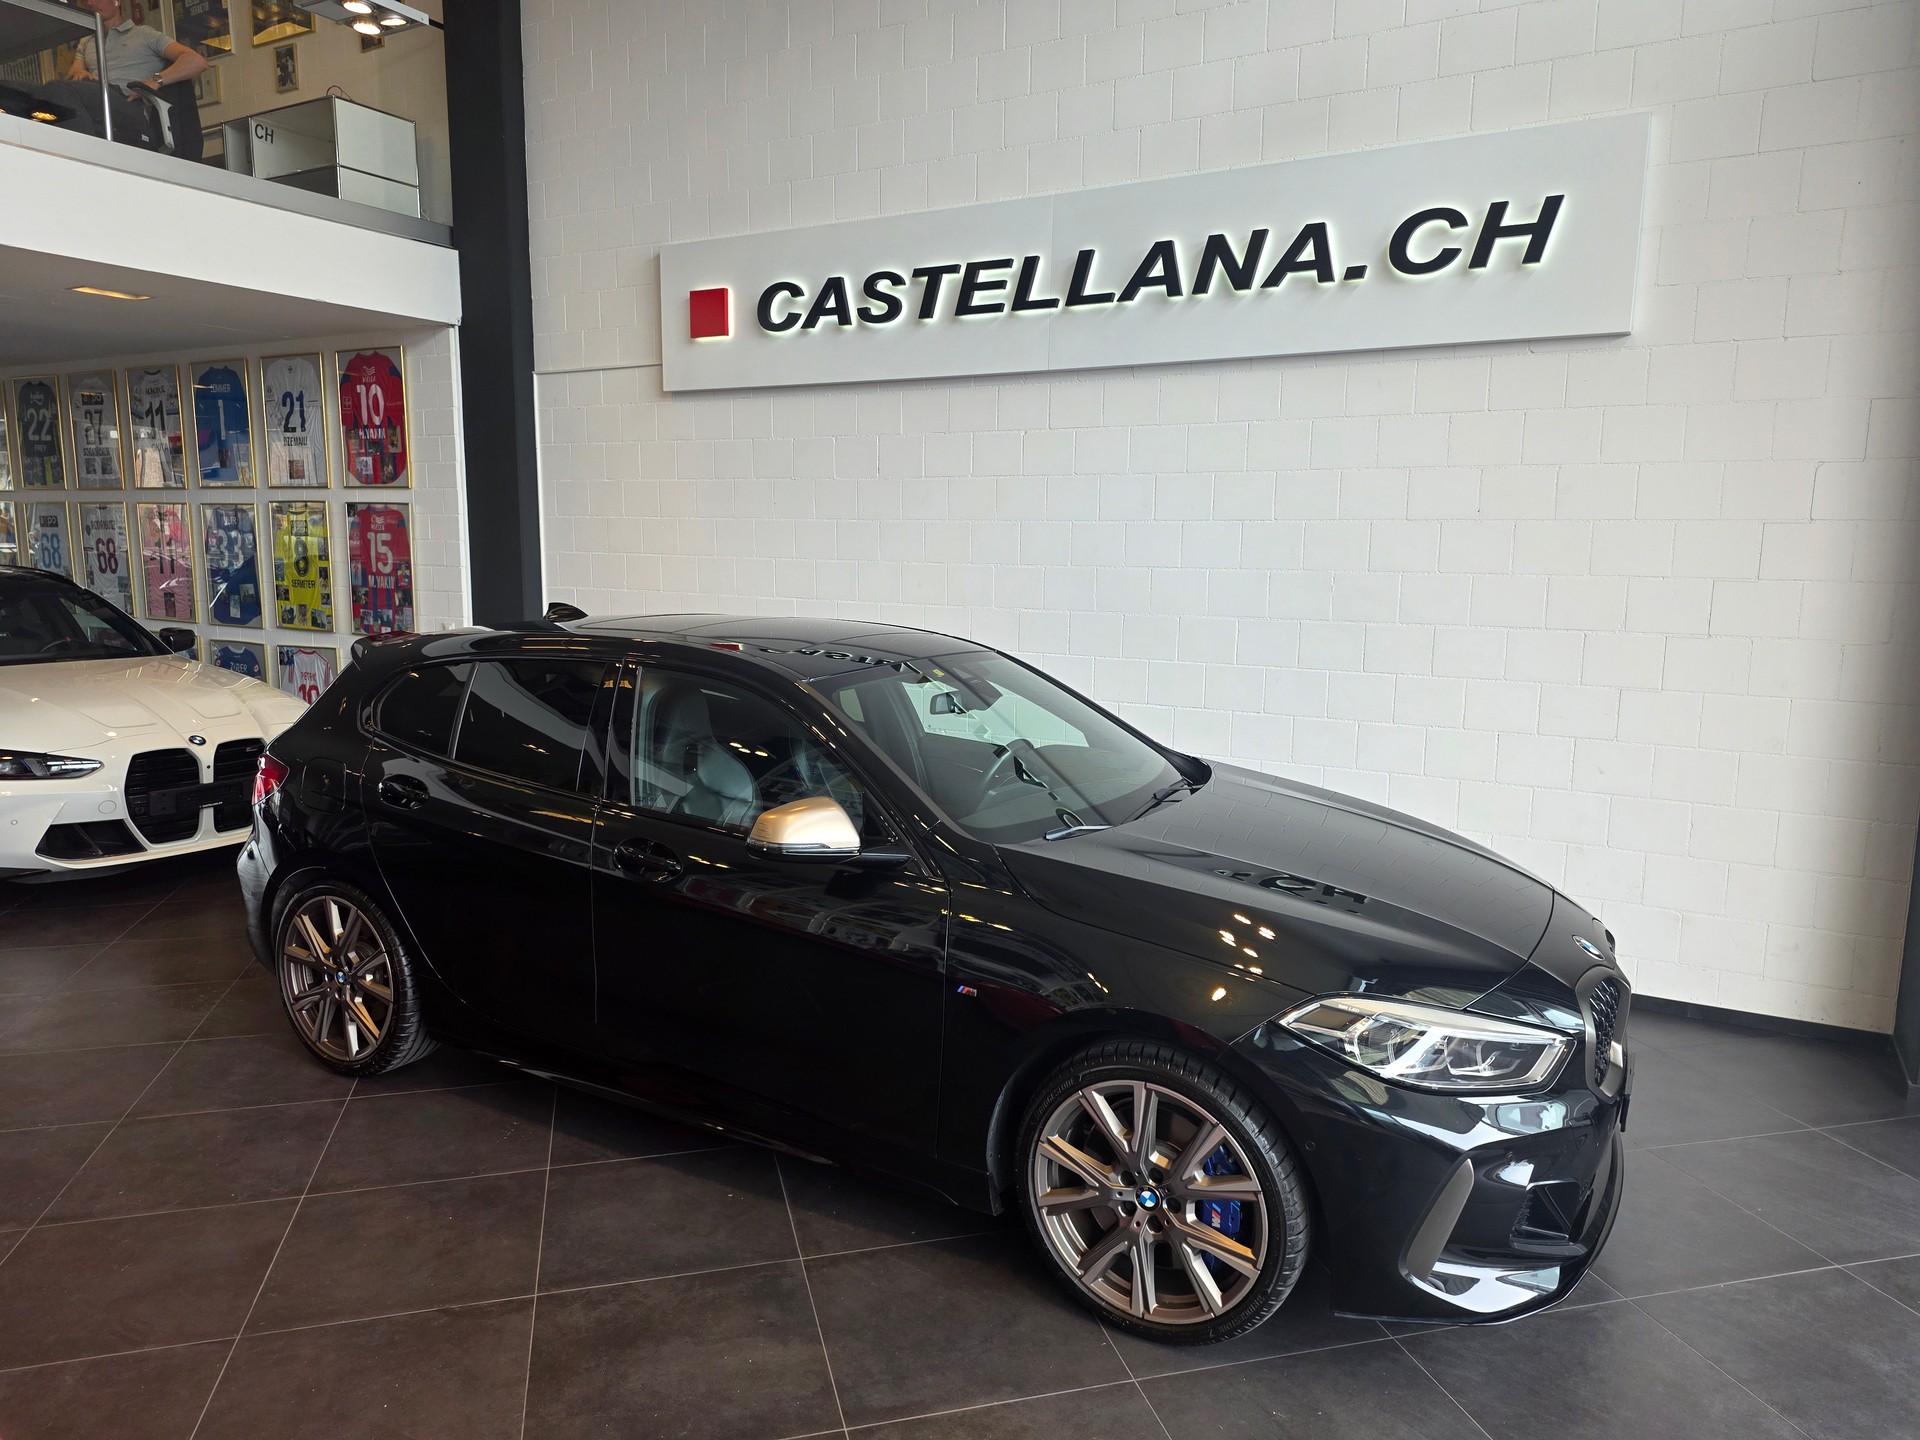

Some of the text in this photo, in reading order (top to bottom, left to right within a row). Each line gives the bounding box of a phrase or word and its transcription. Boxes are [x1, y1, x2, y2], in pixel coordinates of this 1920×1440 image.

[255, 124, 273, 144] CH
[757, 194, 1564, 332] CASTELLANA.CH
[27, 408, 51, 440] 22
[145, 400, 166, 439] 11
[218, 400, 226, 440] 1
[282, 391, 306, 432] 21
[356, 384, 384, 425] 10
[85, 409, 103, 445] 27
[41, 533, 62, 568] 68
[96, 538, 118, 574] 68
[217, 529, 244, 569] 33
[294, 537, 309, 577] 8
[367, 532, 393, 573] 15
